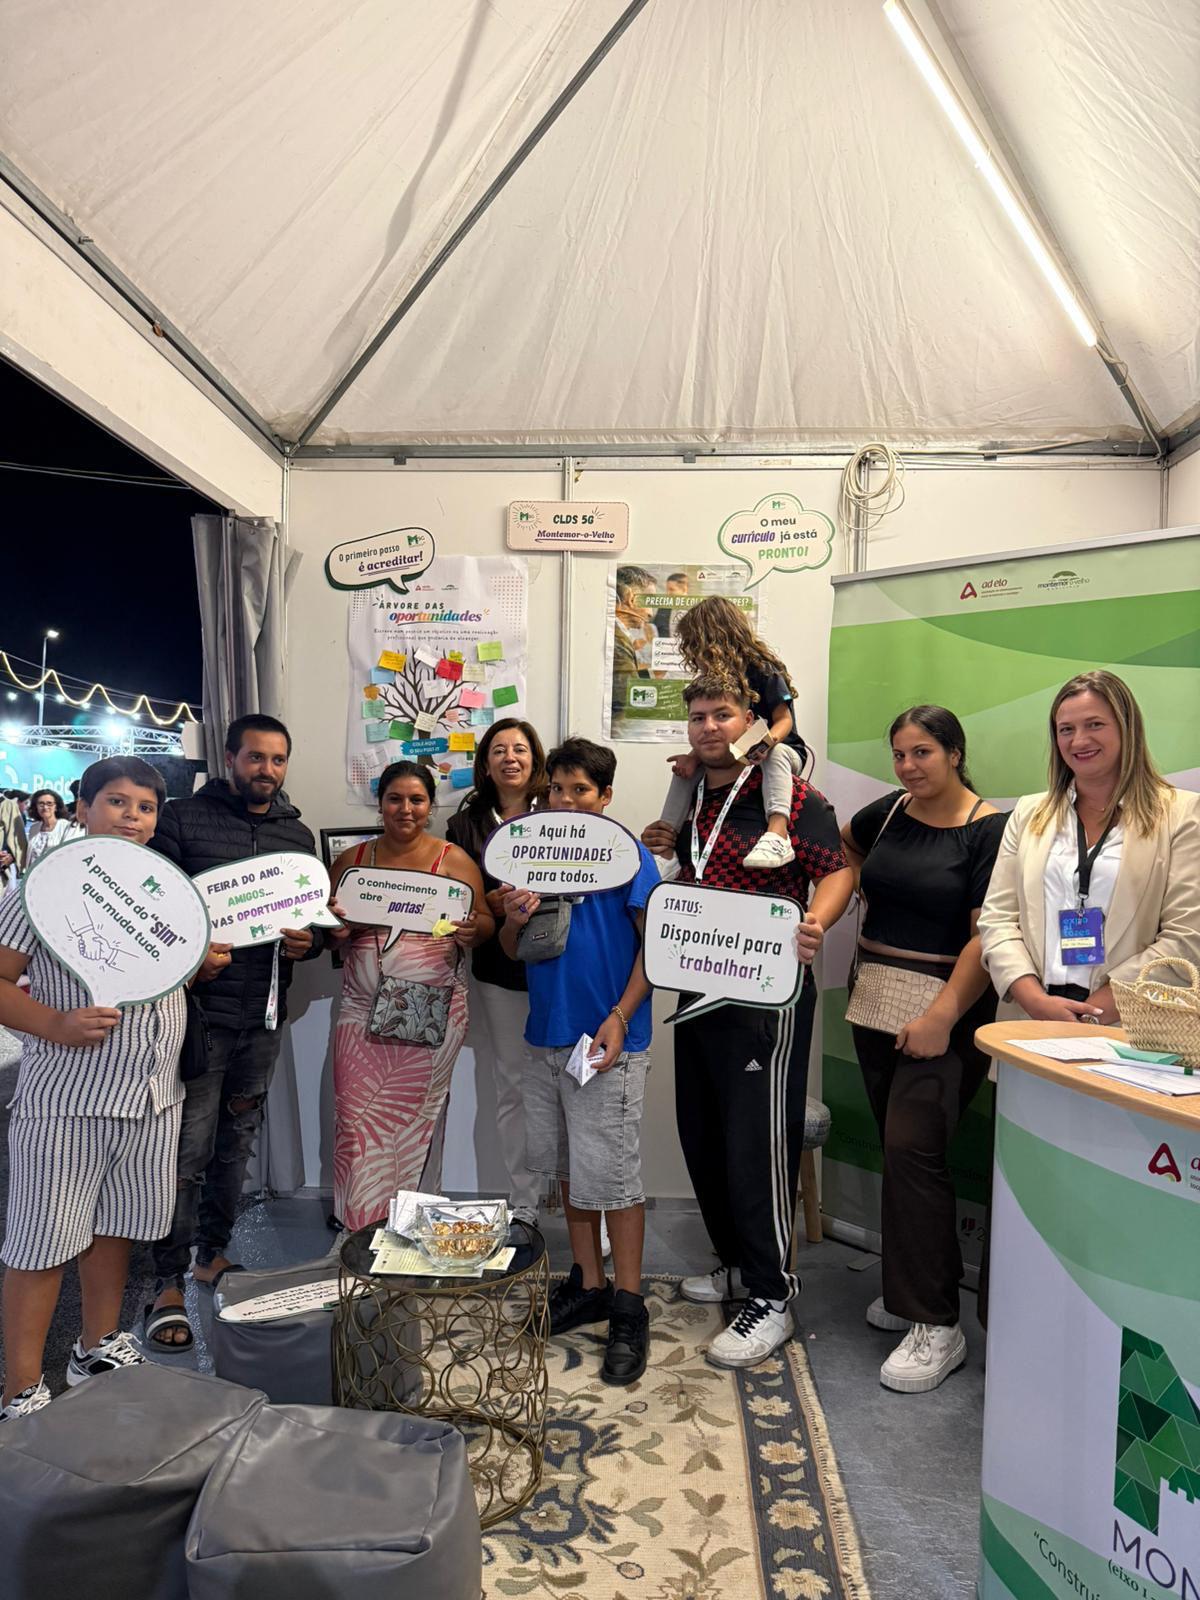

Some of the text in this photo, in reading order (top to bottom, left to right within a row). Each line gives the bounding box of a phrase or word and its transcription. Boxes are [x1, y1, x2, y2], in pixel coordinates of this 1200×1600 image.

[553, 515, 594, 525] CLDS 5G
[760, 517, 796, 527] O meu
[537, 530, 615, 539] Montemor-o-Velho
[731, 529, 818, 544] currículo já está
[339, 545, 400, 562] O primeiro passo
[758, 546, 809, 560] PRONTO!
[358, 551, 423, 572] é acreditar!
[379, 600, 444, 610] ÁRVORE DAS
[646, 597, 673, 606] PRECISA
[675, 597, 684, 606] DE
[389, 610, 482, 623] oportunidades
[539, 824, 586, 841] Aqui há
[82, 854, 96, 866] À
[512, 845, 613, 862] OPORTUNIDADES
[207, 878, 239, 895] FEIRA
[241, 873, 255, 885] DO
[527, 870, 598, 884] para todos.
[88, 864, 135, 907] procura
[358, 877, 437, 896] O conhecimento
[360, 891, 382, 902] abre
[133, 904, 148, 920] do
[212, 889, 324, 929] VAS OPORTUNIDADES!
[387, 901, 425, 914] portas!
[664, 897, 702, 914] STATUS:
[82, 882, 161, 962] que muda tudo.
[660, 923, 783, 956] Disponível para
[679, 954, 762, 981] trabalhar!
[1108, 1559, 1139, 1591] (eixo
